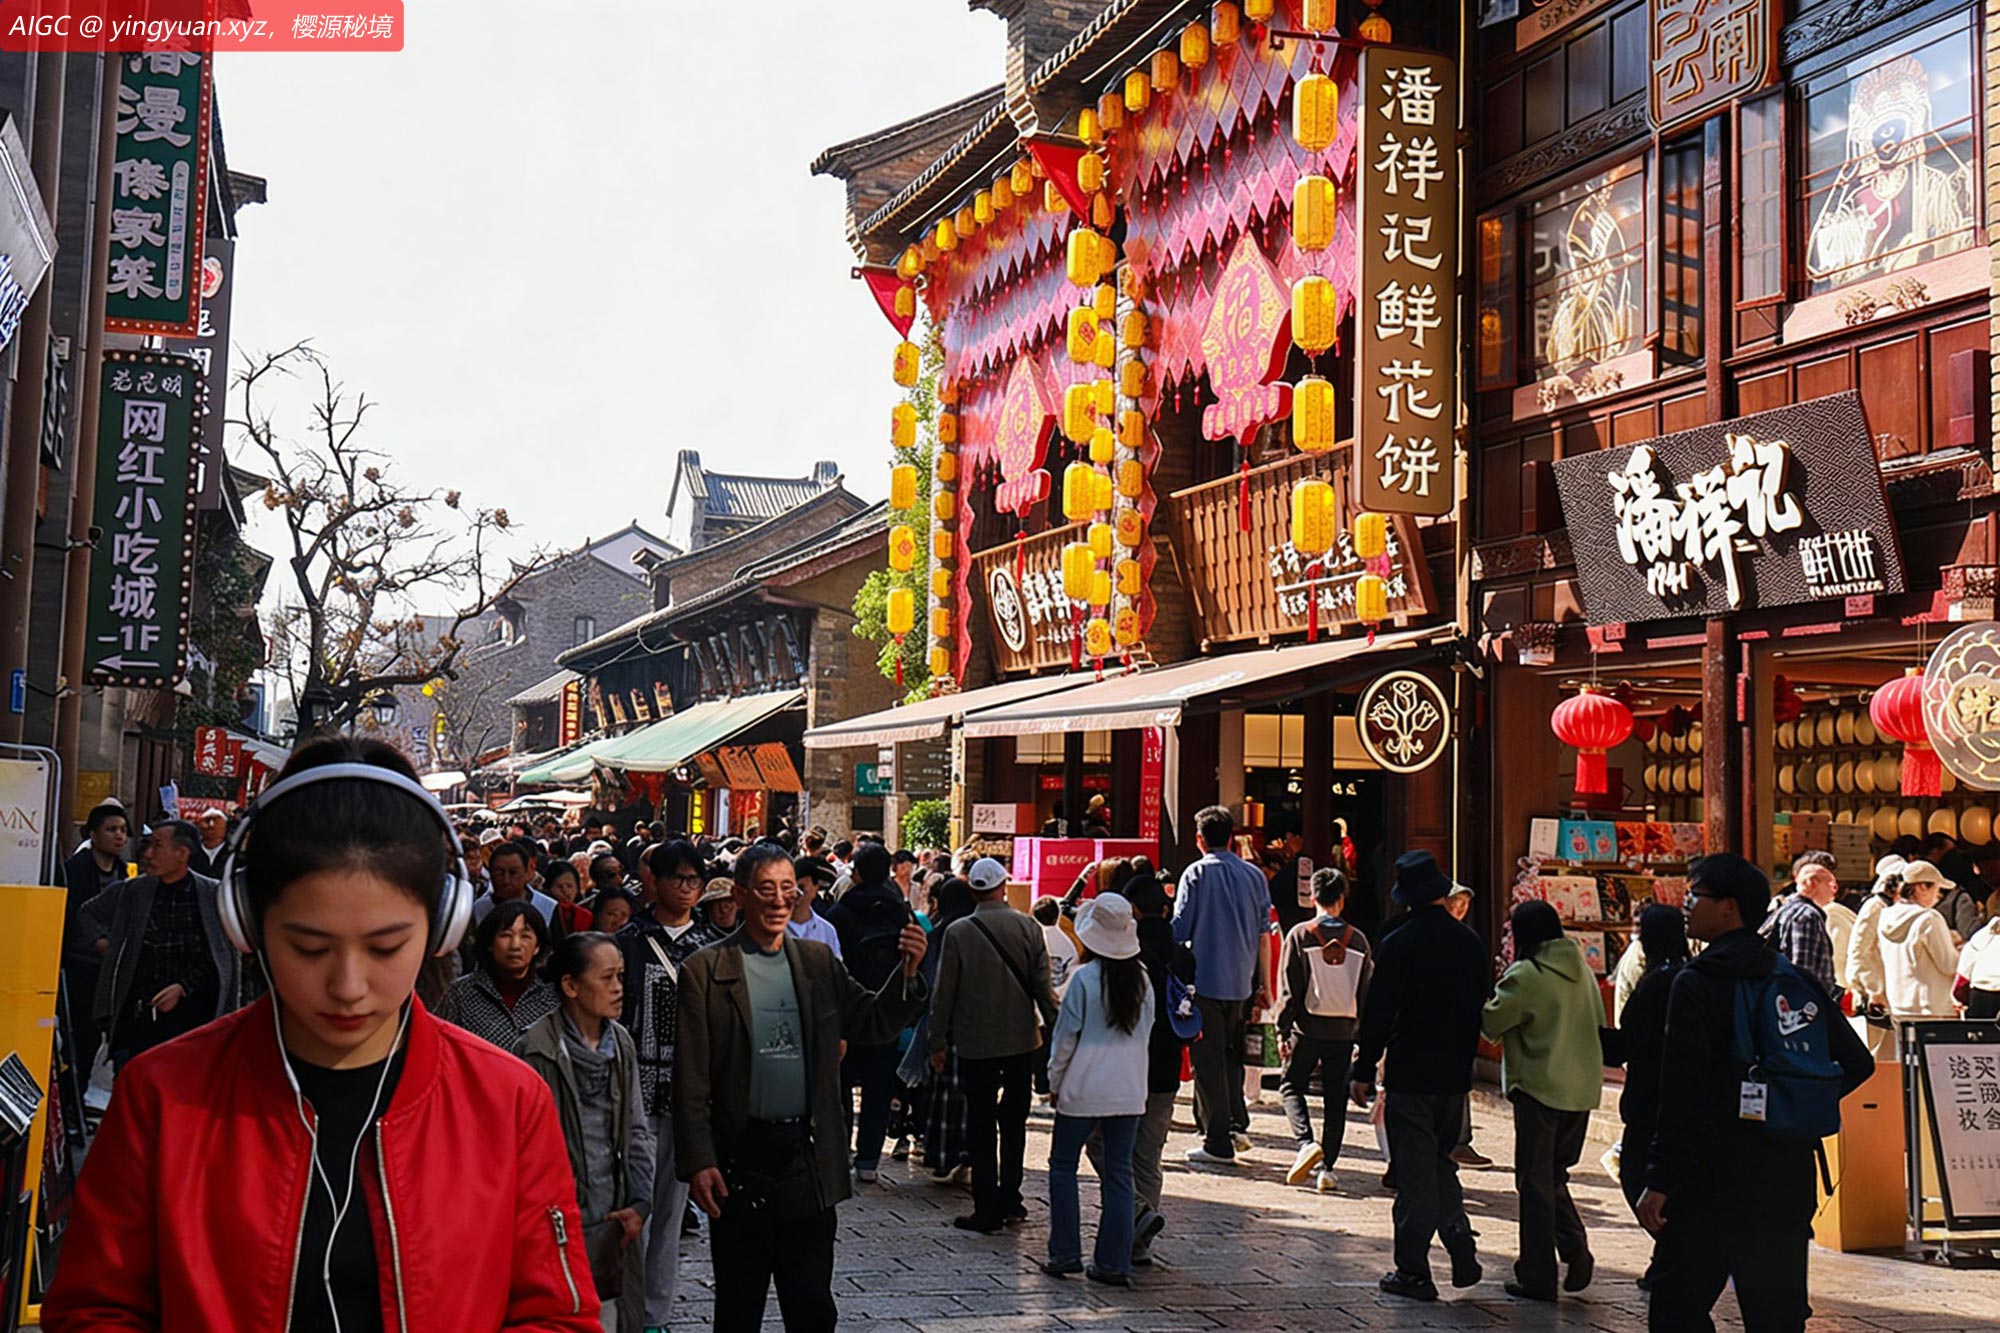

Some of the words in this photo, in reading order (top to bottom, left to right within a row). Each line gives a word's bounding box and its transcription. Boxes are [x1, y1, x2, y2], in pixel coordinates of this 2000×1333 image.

[1374, 66, 1444, 498] 潘祥记鲜花饼
[109, 399, 166, 620] 网红小吃城
[1608, 433, 1804, 610] 潘祥记
